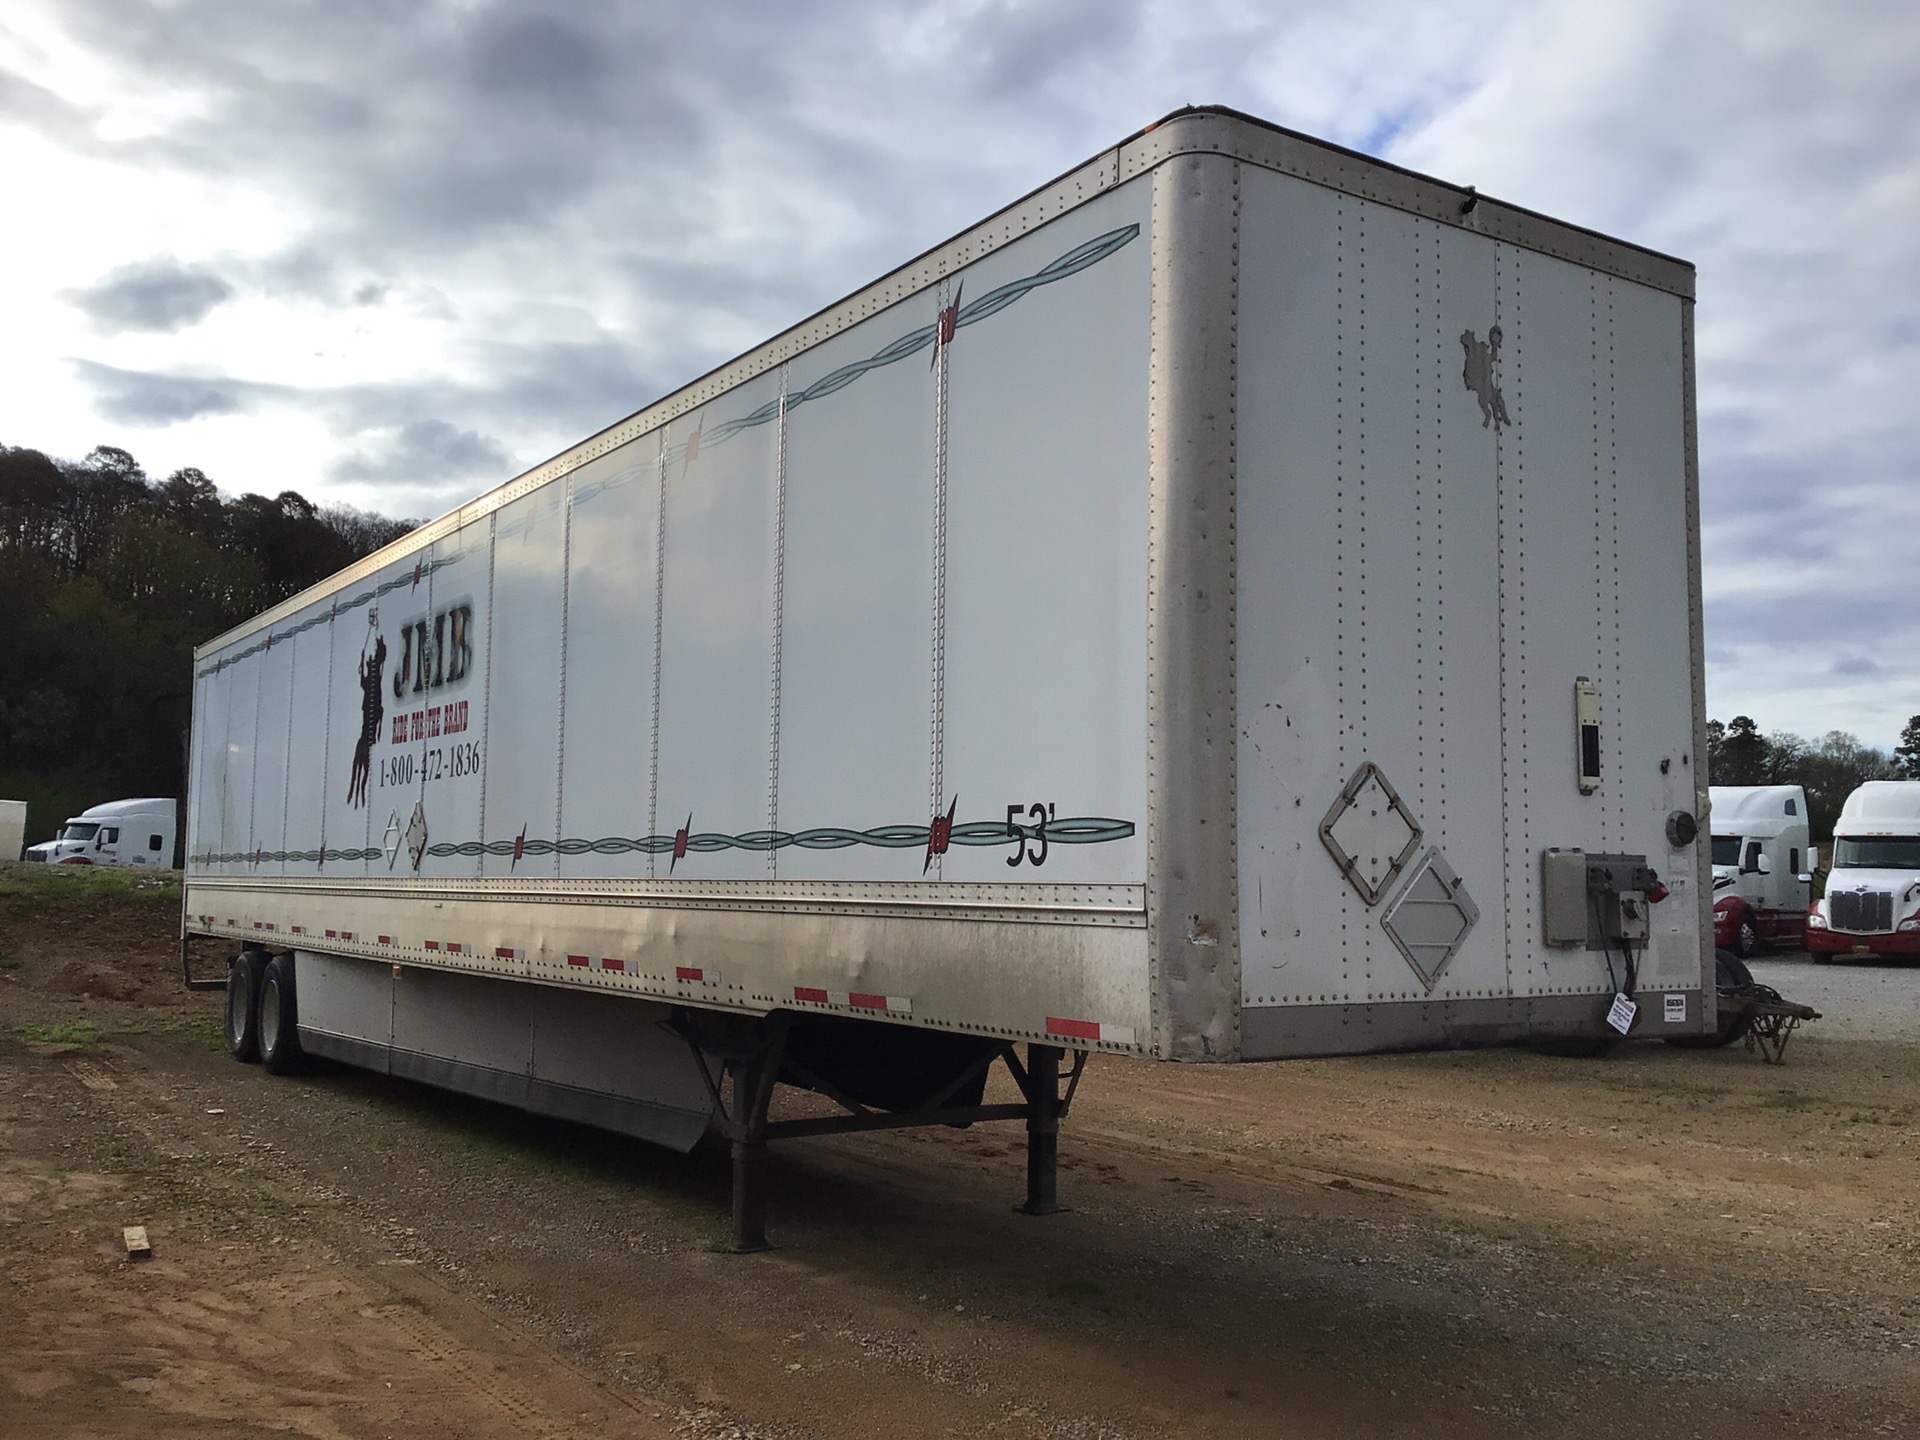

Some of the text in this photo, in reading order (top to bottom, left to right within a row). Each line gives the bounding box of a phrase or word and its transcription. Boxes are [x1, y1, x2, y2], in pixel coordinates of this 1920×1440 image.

[392, 700, 468, 744] RIDE FOR THE BRAND
[380, 740, 480, 787] 1-800-472-1836
[1006, 802, 1055, 867] 53'
